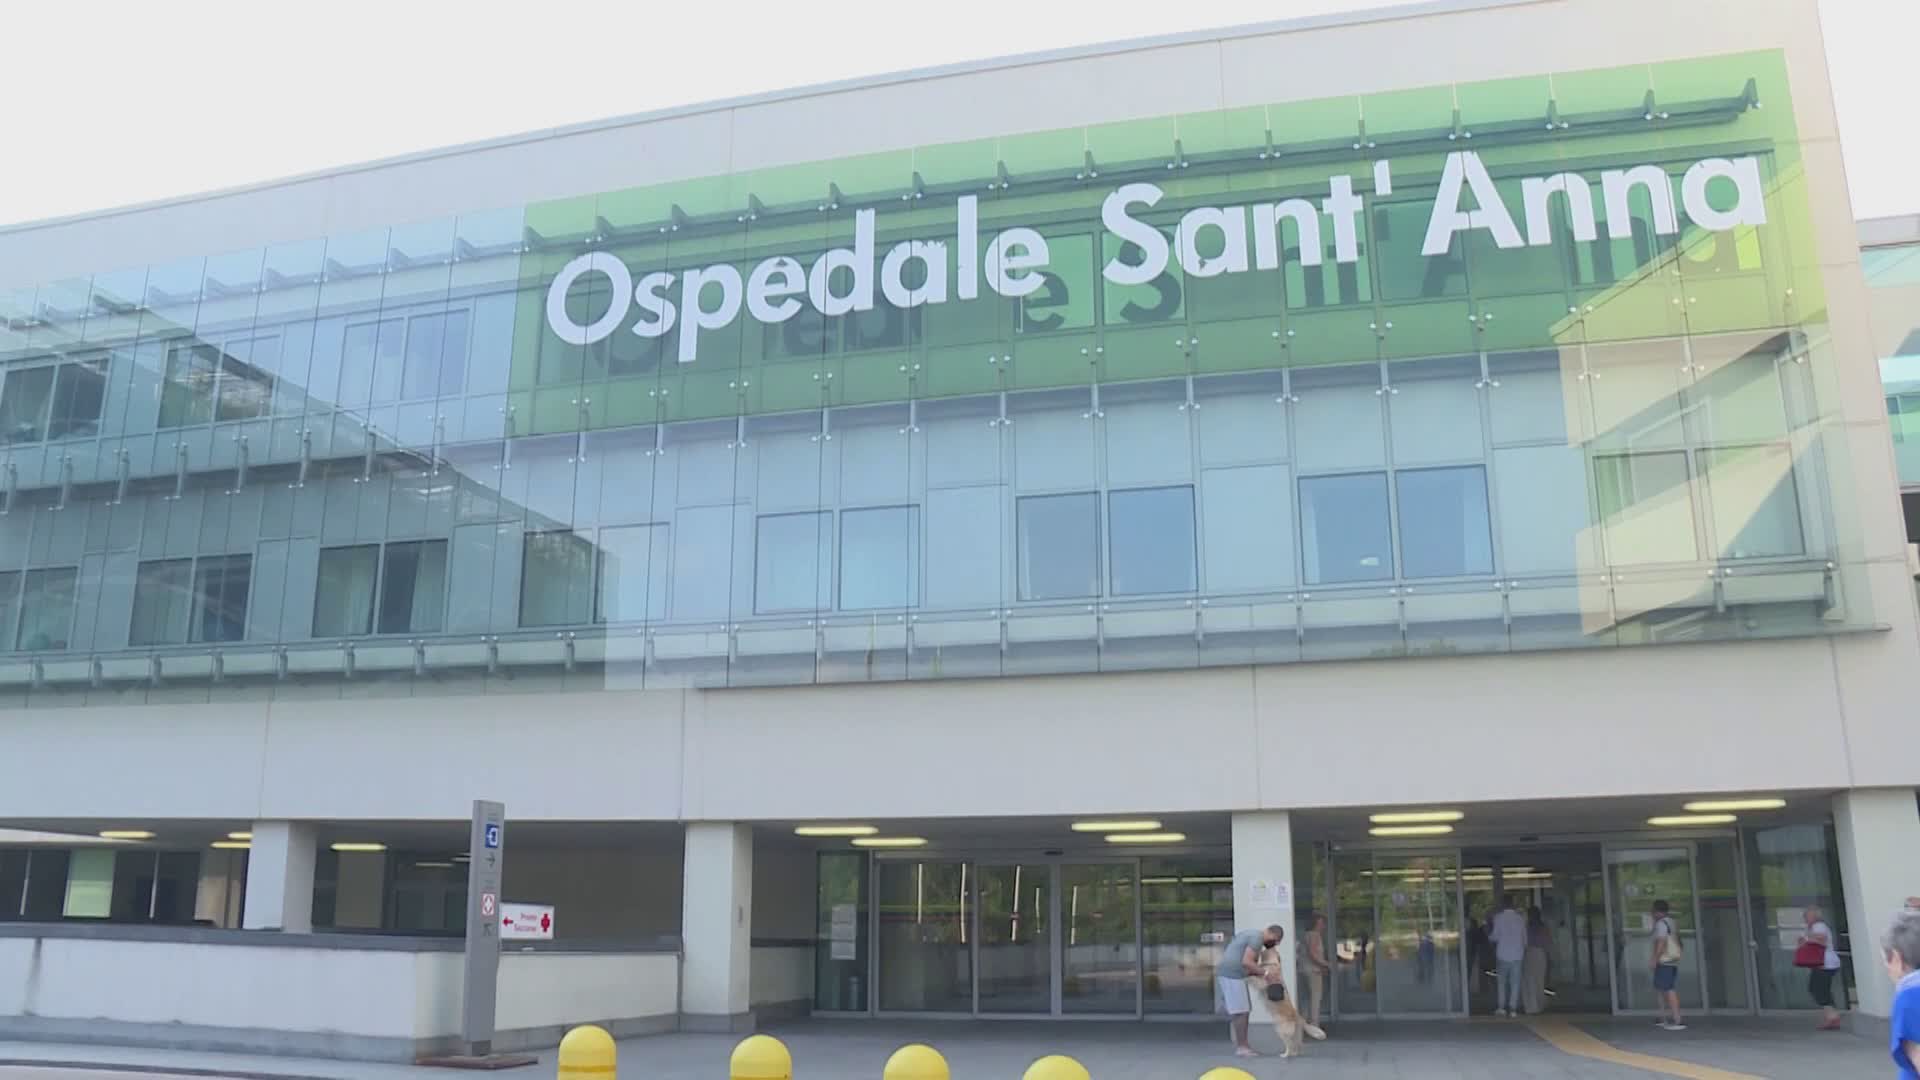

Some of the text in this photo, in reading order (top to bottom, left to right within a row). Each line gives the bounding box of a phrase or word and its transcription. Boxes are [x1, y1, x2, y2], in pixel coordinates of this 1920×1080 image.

[546, 151, 1767, 362] Ospedale Sant' Anna
